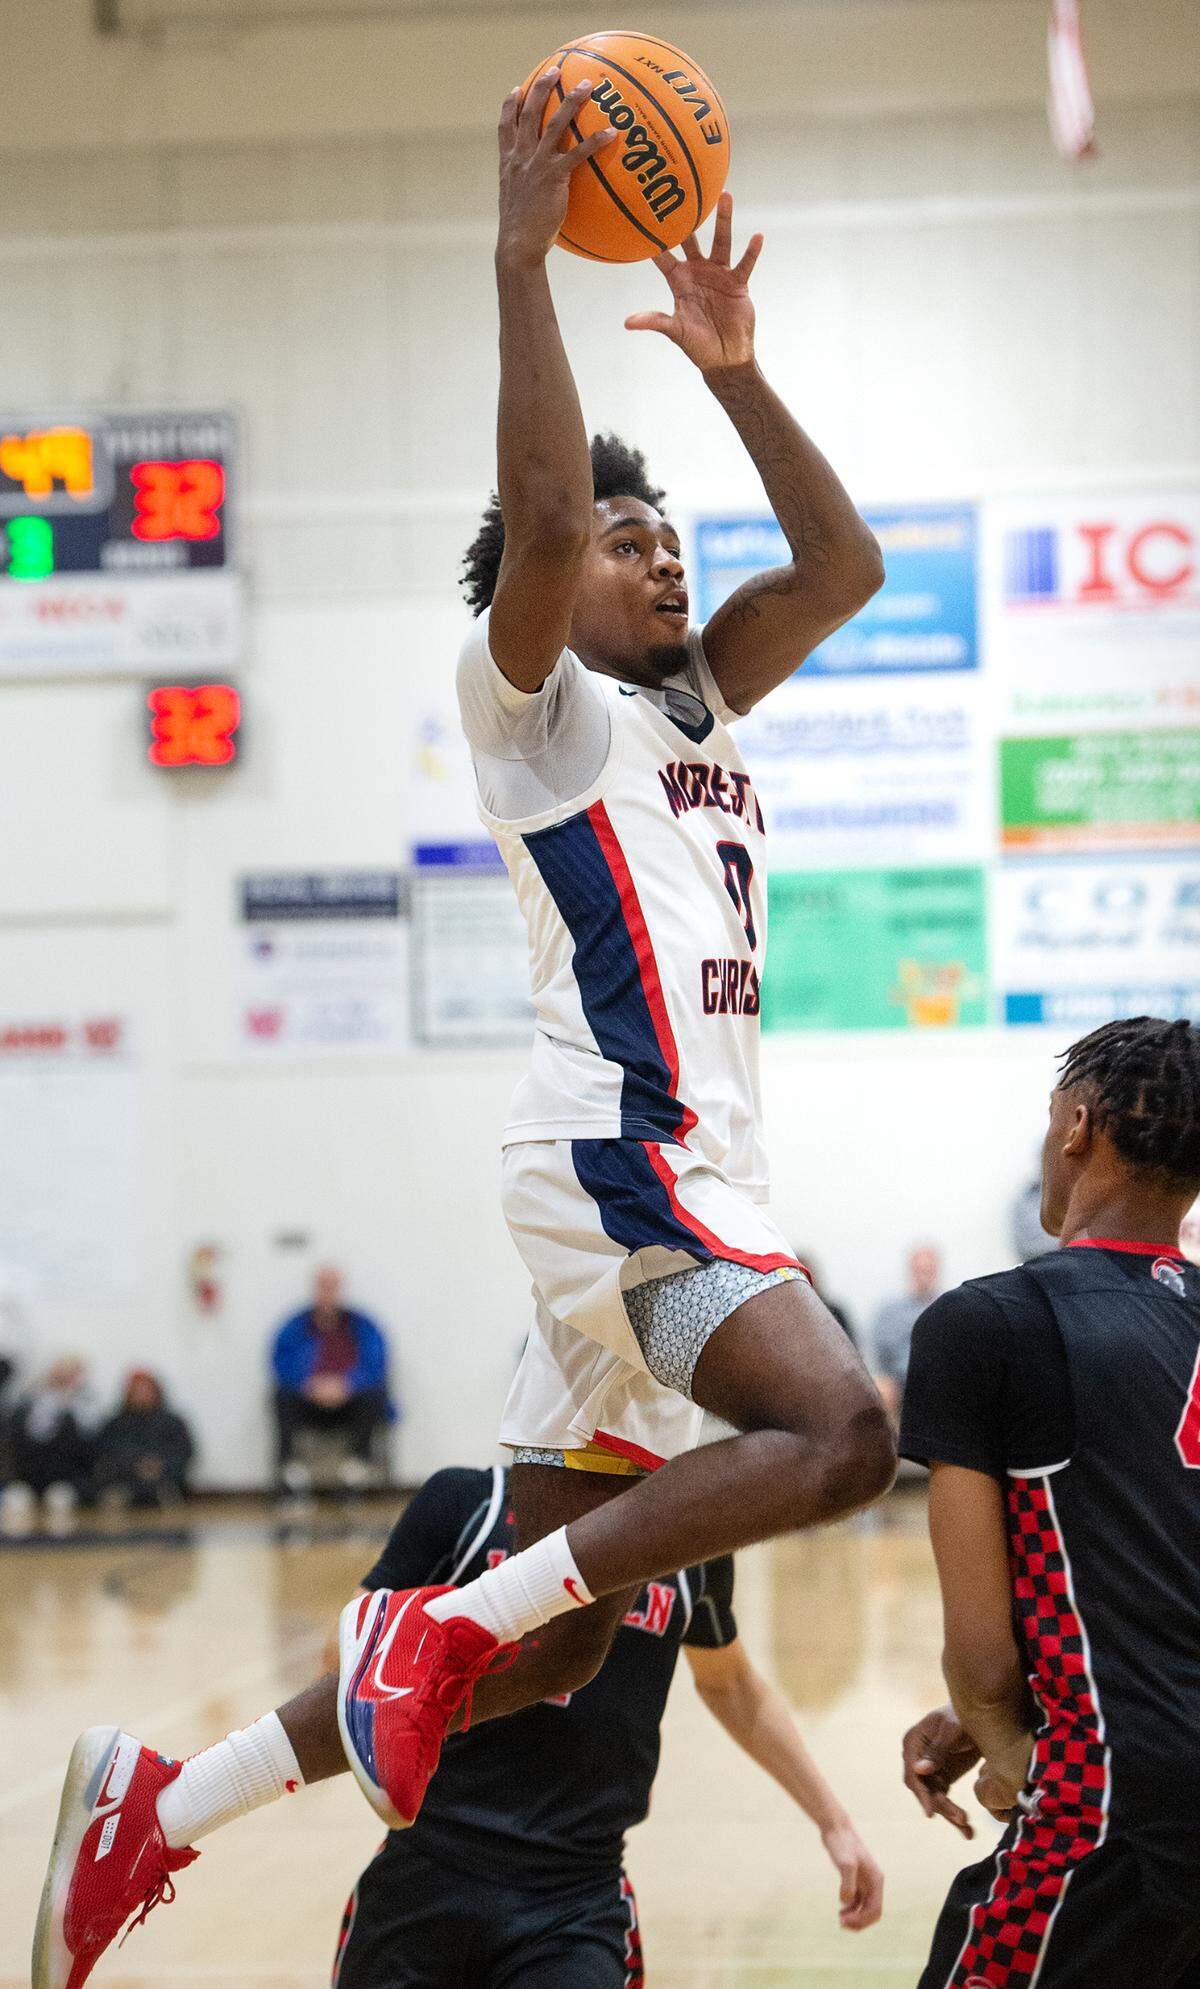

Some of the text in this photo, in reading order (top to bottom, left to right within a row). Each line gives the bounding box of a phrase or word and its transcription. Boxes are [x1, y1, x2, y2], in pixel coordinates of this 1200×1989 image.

[634, 56, 724, 146] EVO NXT
[590, 77, 686, 224] Wilson
[130, 460, 225, 542] 32
[147, 684, 241, 766] 32
[657, 759, 766, 836] MODEST
[715, 839, 757, 953] 0
